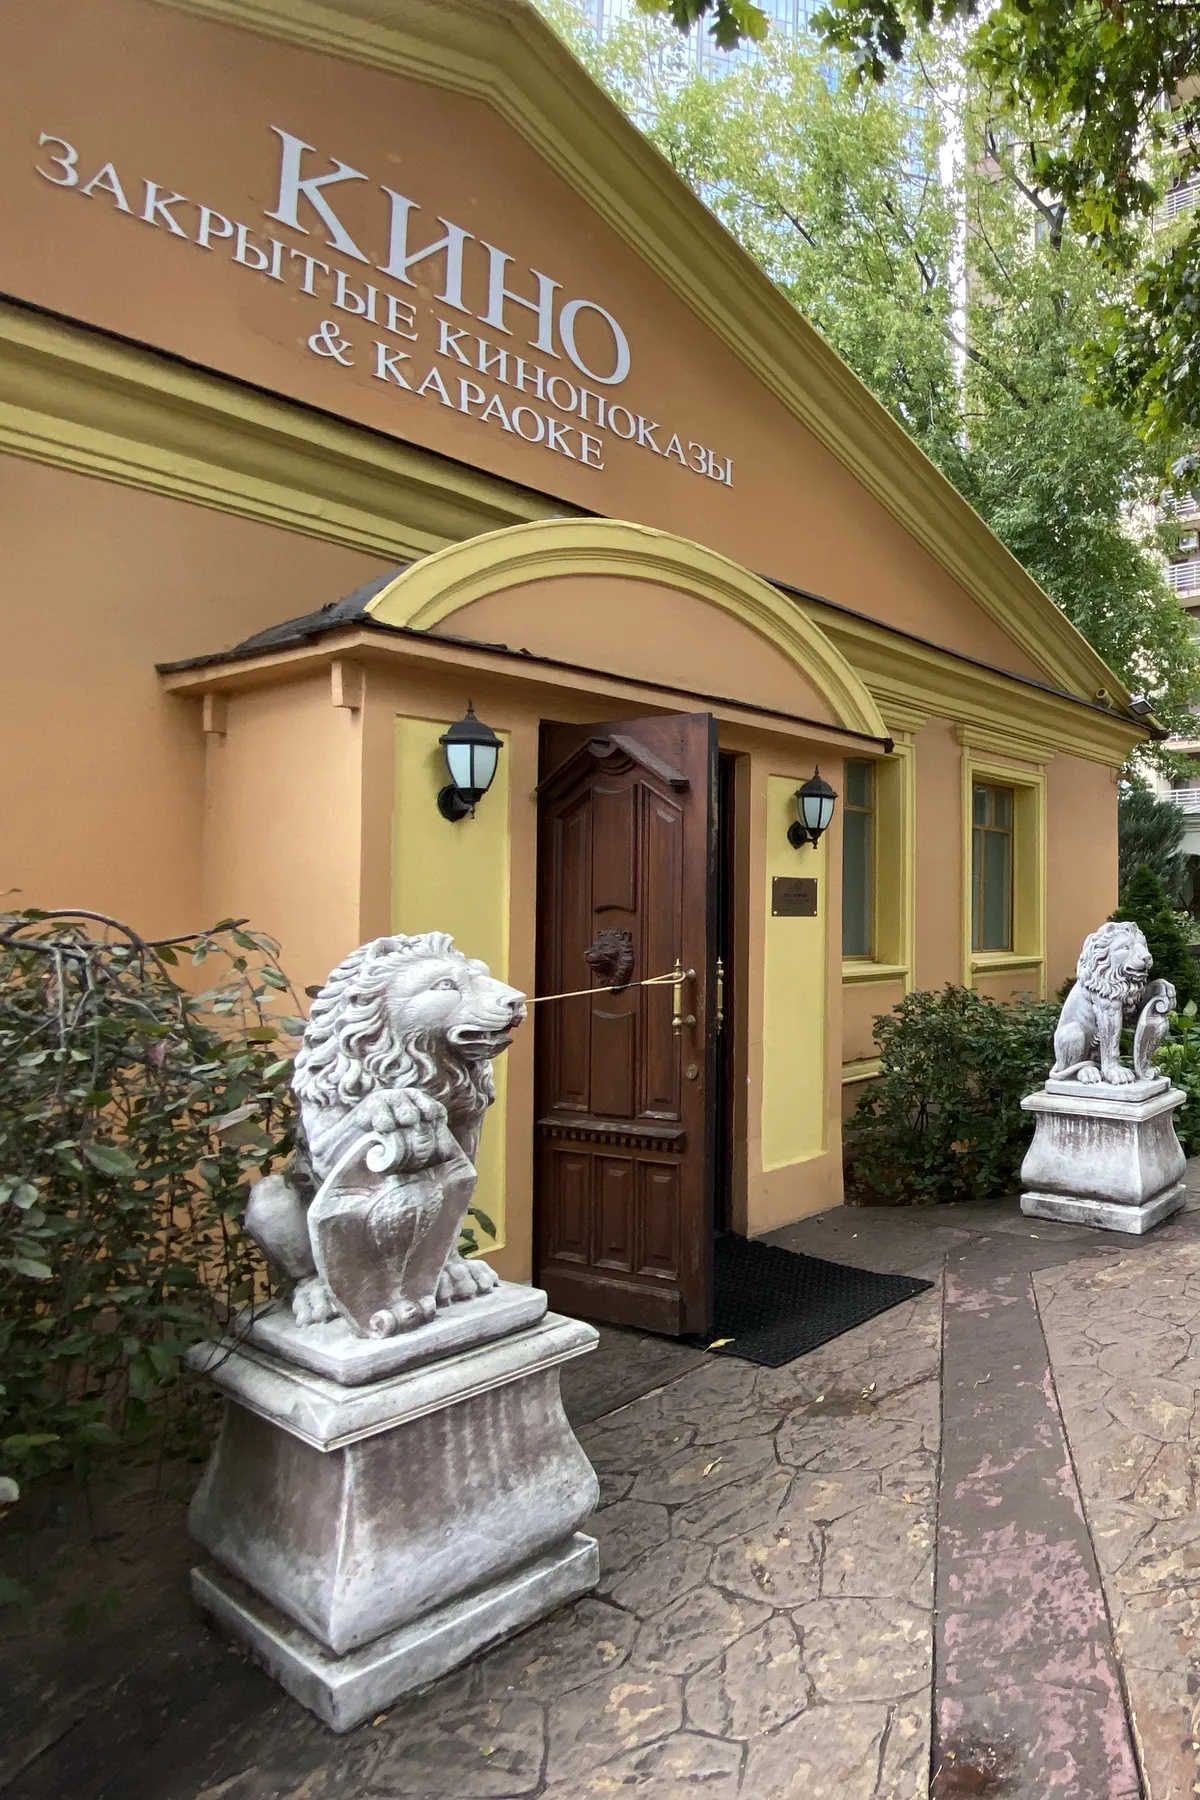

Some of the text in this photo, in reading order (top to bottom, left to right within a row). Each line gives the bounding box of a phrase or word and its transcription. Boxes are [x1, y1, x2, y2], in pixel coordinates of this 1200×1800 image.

[35, 131, 734, 487] ЗАКРЫТЫЕ КИНОПОКАЗЫ
[264, 124, 631, 385] КИНО
[308, 320, 605, 470] & КАРАОКЕ
